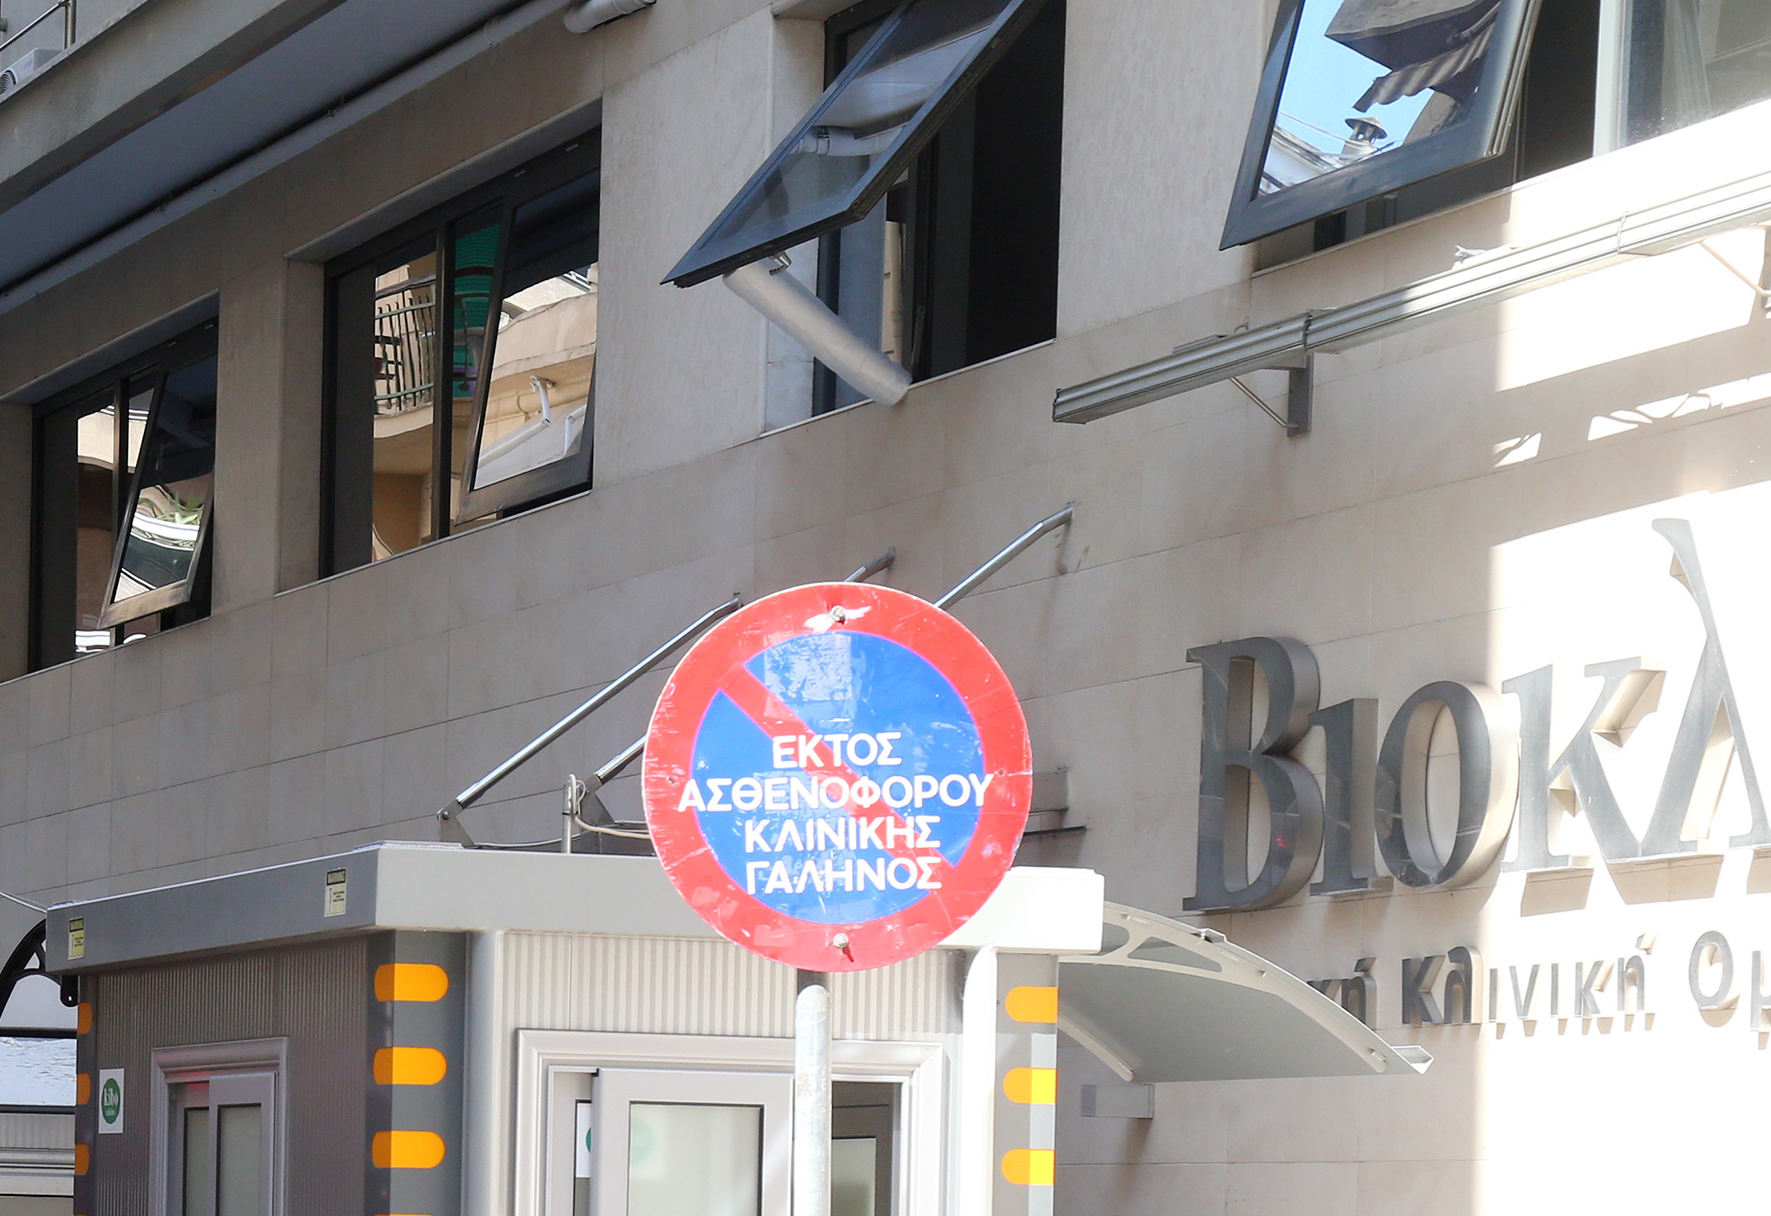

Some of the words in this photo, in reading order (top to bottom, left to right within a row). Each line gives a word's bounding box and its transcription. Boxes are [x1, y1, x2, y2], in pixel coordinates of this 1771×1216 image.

[772, 732, 902, 769] ΕΚΤΟΣ
[677, 773, 994, 812] ΑΣΘΕΝΟΦΟΡΟΥ
[744, 815, 940, 853] ΚΛΙΝΙΚΗΣ
[746, 856, 942, 895] ΓΑΛΗΝΟΣ
[1402, 933, 1657, 1025] κλινική
